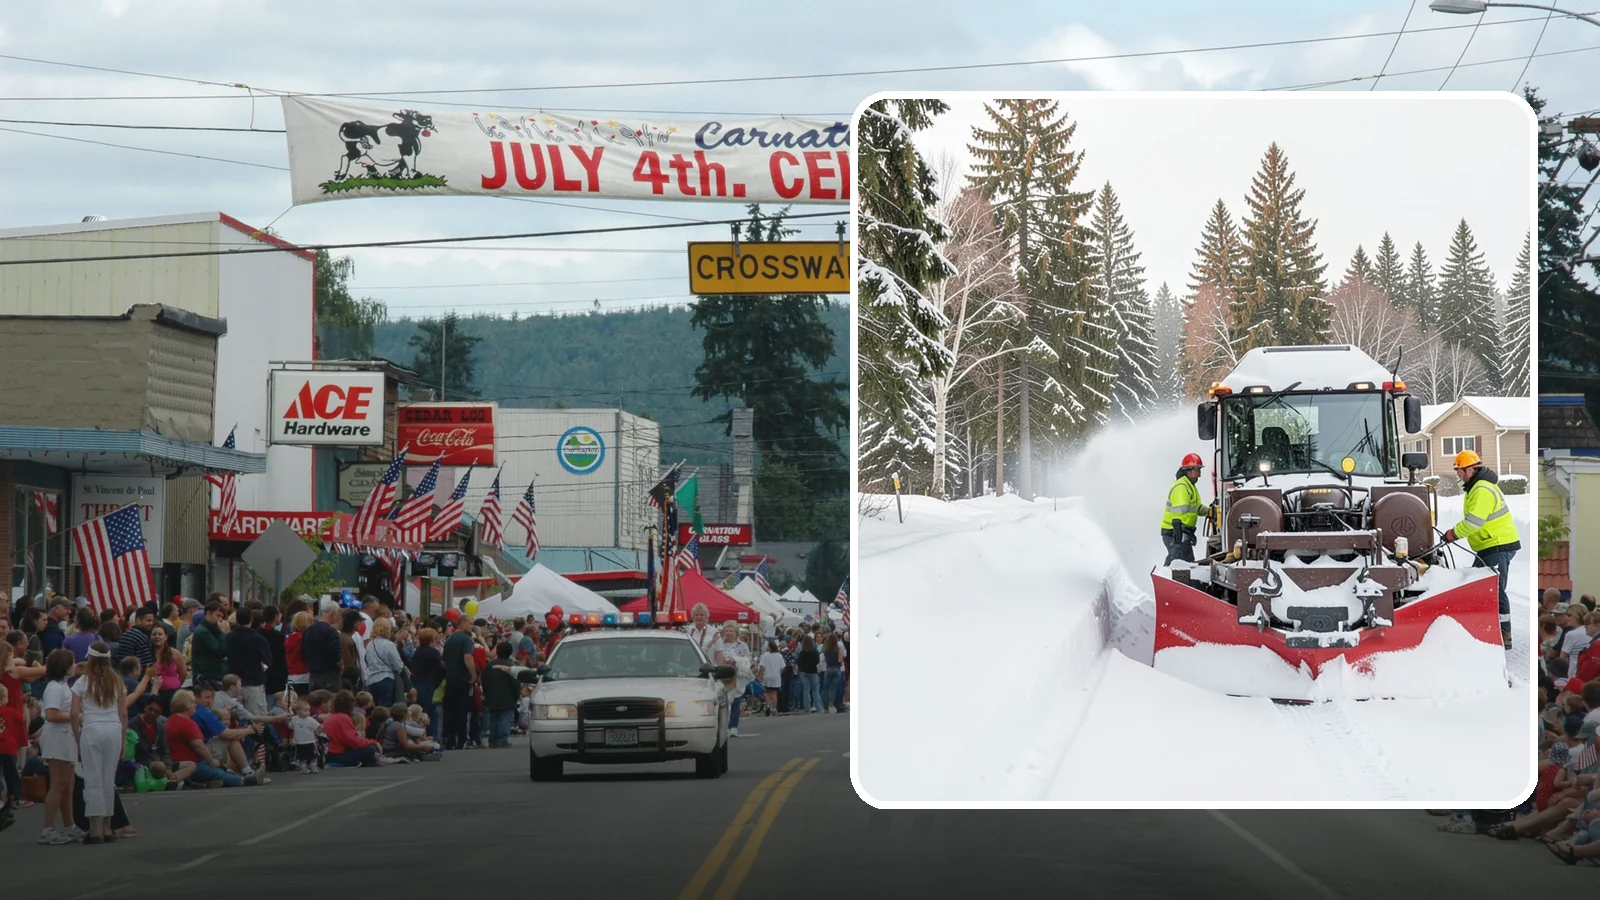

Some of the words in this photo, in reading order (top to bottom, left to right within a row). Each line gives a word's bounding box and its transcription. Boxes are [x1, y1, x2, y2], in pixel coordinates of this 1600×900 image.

[695, 122, 850, 149] Carnat
[481, 141, 605, 192] JULY
[632, 150, 746, 198] 4th.
[697, 254, 850, 280] CROSSWA
[282, 380, 373, 420] ACE
[405, 409, 453, 421] CEDAR
[461, 409, 485, 421] LOG
[283, 421, 371, 436] Hardware
[416, 428, 477, 447] Coca-Cola
[83, 485, 93, 494] St.
[96, 485, 124, 495] Vincent
[126, 486, 136, 495] de
[137, 486, 155, 495] Paul
[688, 526, 742, 535] CRNATION
[699, 535, 730, 543] GLASS
